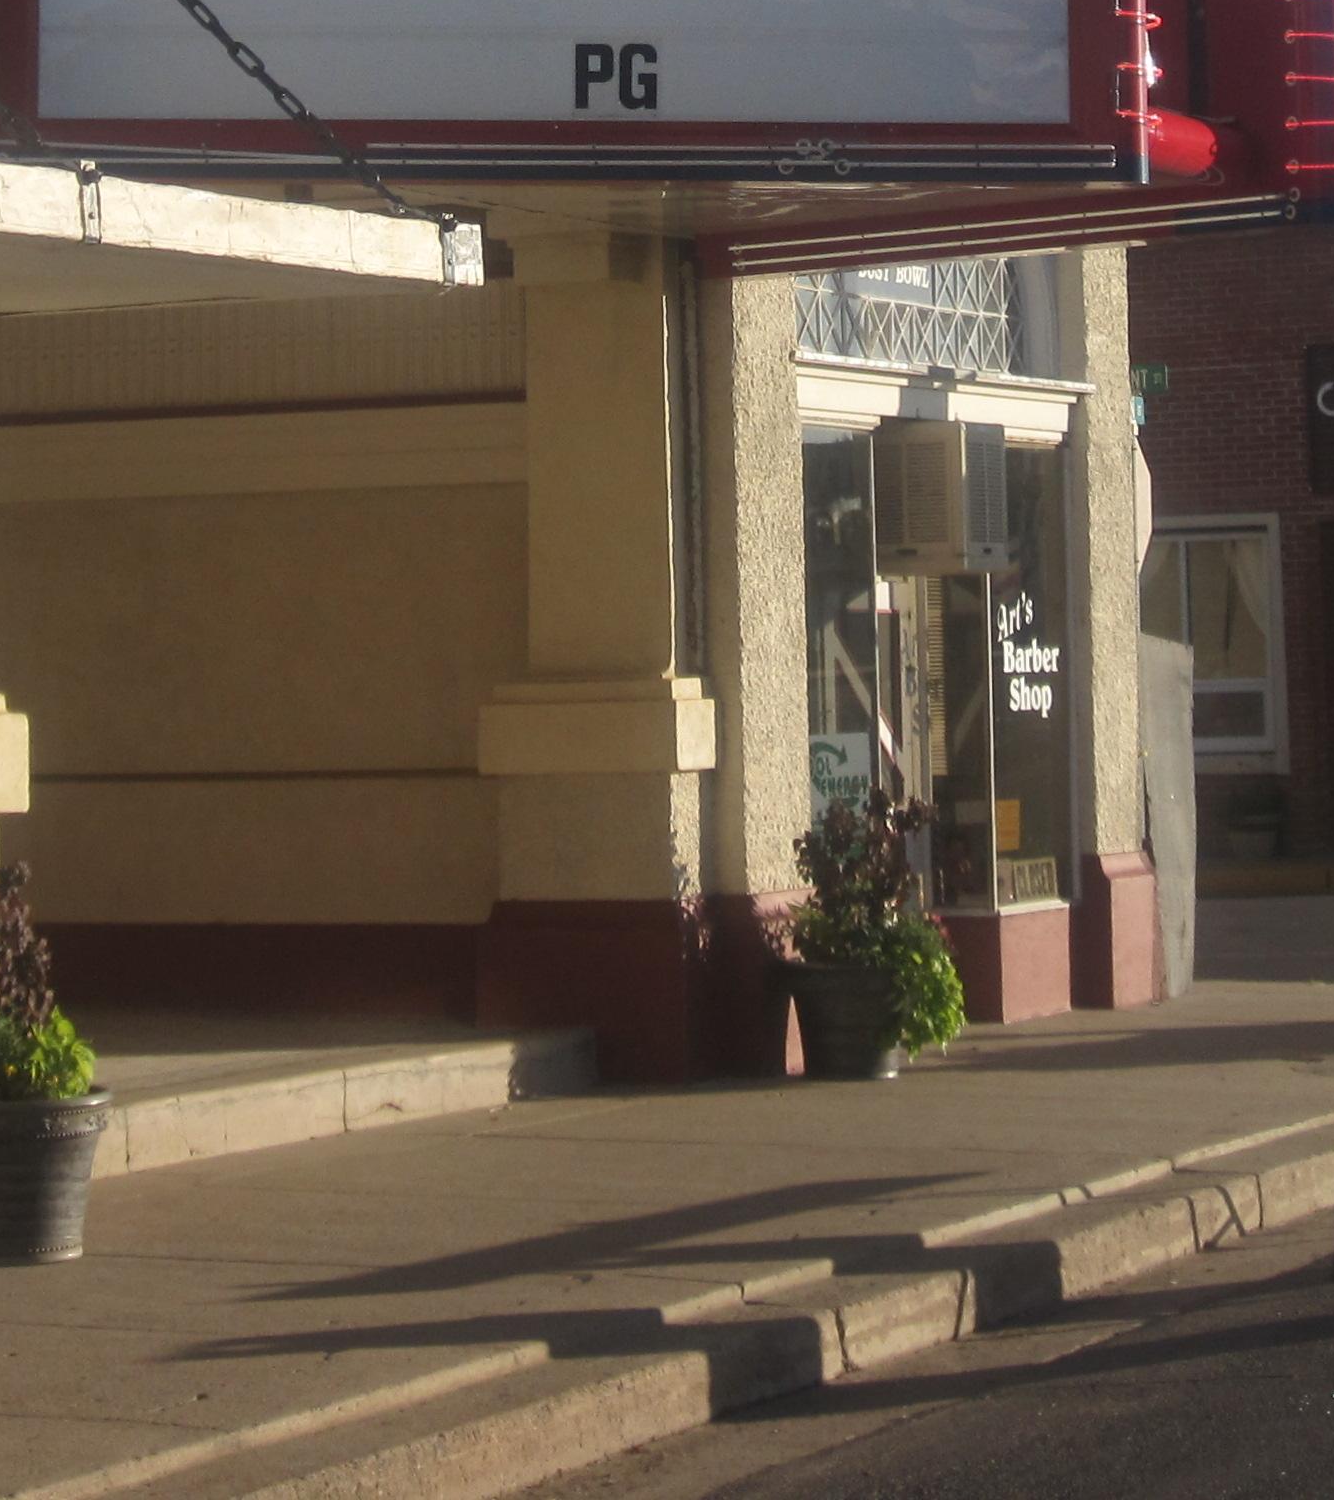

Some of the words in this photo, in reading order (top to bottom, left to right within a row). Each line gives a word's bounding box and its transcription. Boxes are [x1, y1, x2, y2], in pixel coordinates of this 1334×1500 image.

[572, 42, 660, 113] PG
[895, 265, 930, 288] BOWL
[996, 590, 1033, 642] Art's
[1002, 637, 1060, 673] Barber
[1008, 675, 1053, 719] Shop
